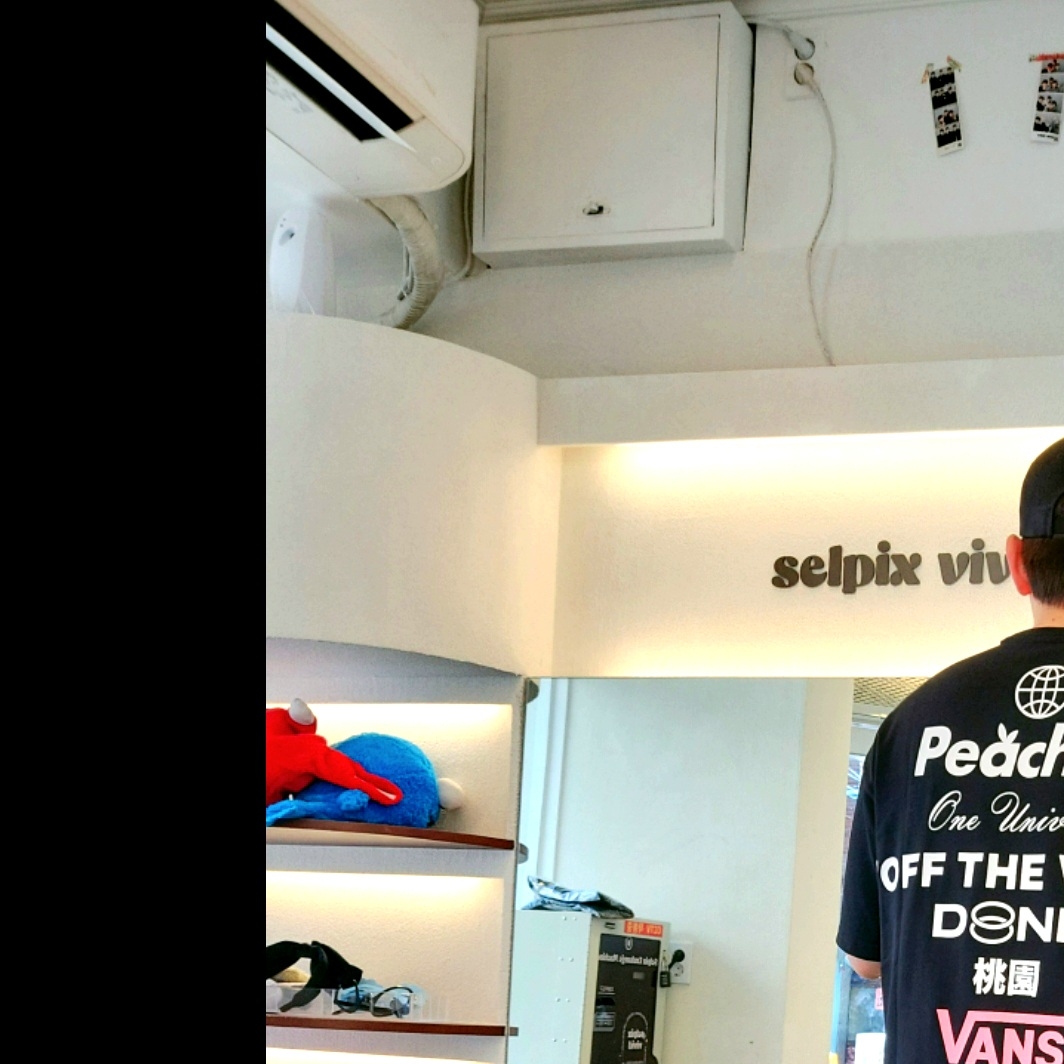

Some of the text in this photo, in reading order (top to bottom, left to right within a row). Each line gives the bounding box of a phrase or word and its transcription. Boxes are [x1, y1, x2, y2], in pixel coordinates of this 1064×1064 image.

[772, 539, 1010, 594] selpix viv
[928, 789, 981, 831] One
[957, 851, 1046, 892] THE
[972, 957, 1040, 998] 桃園
